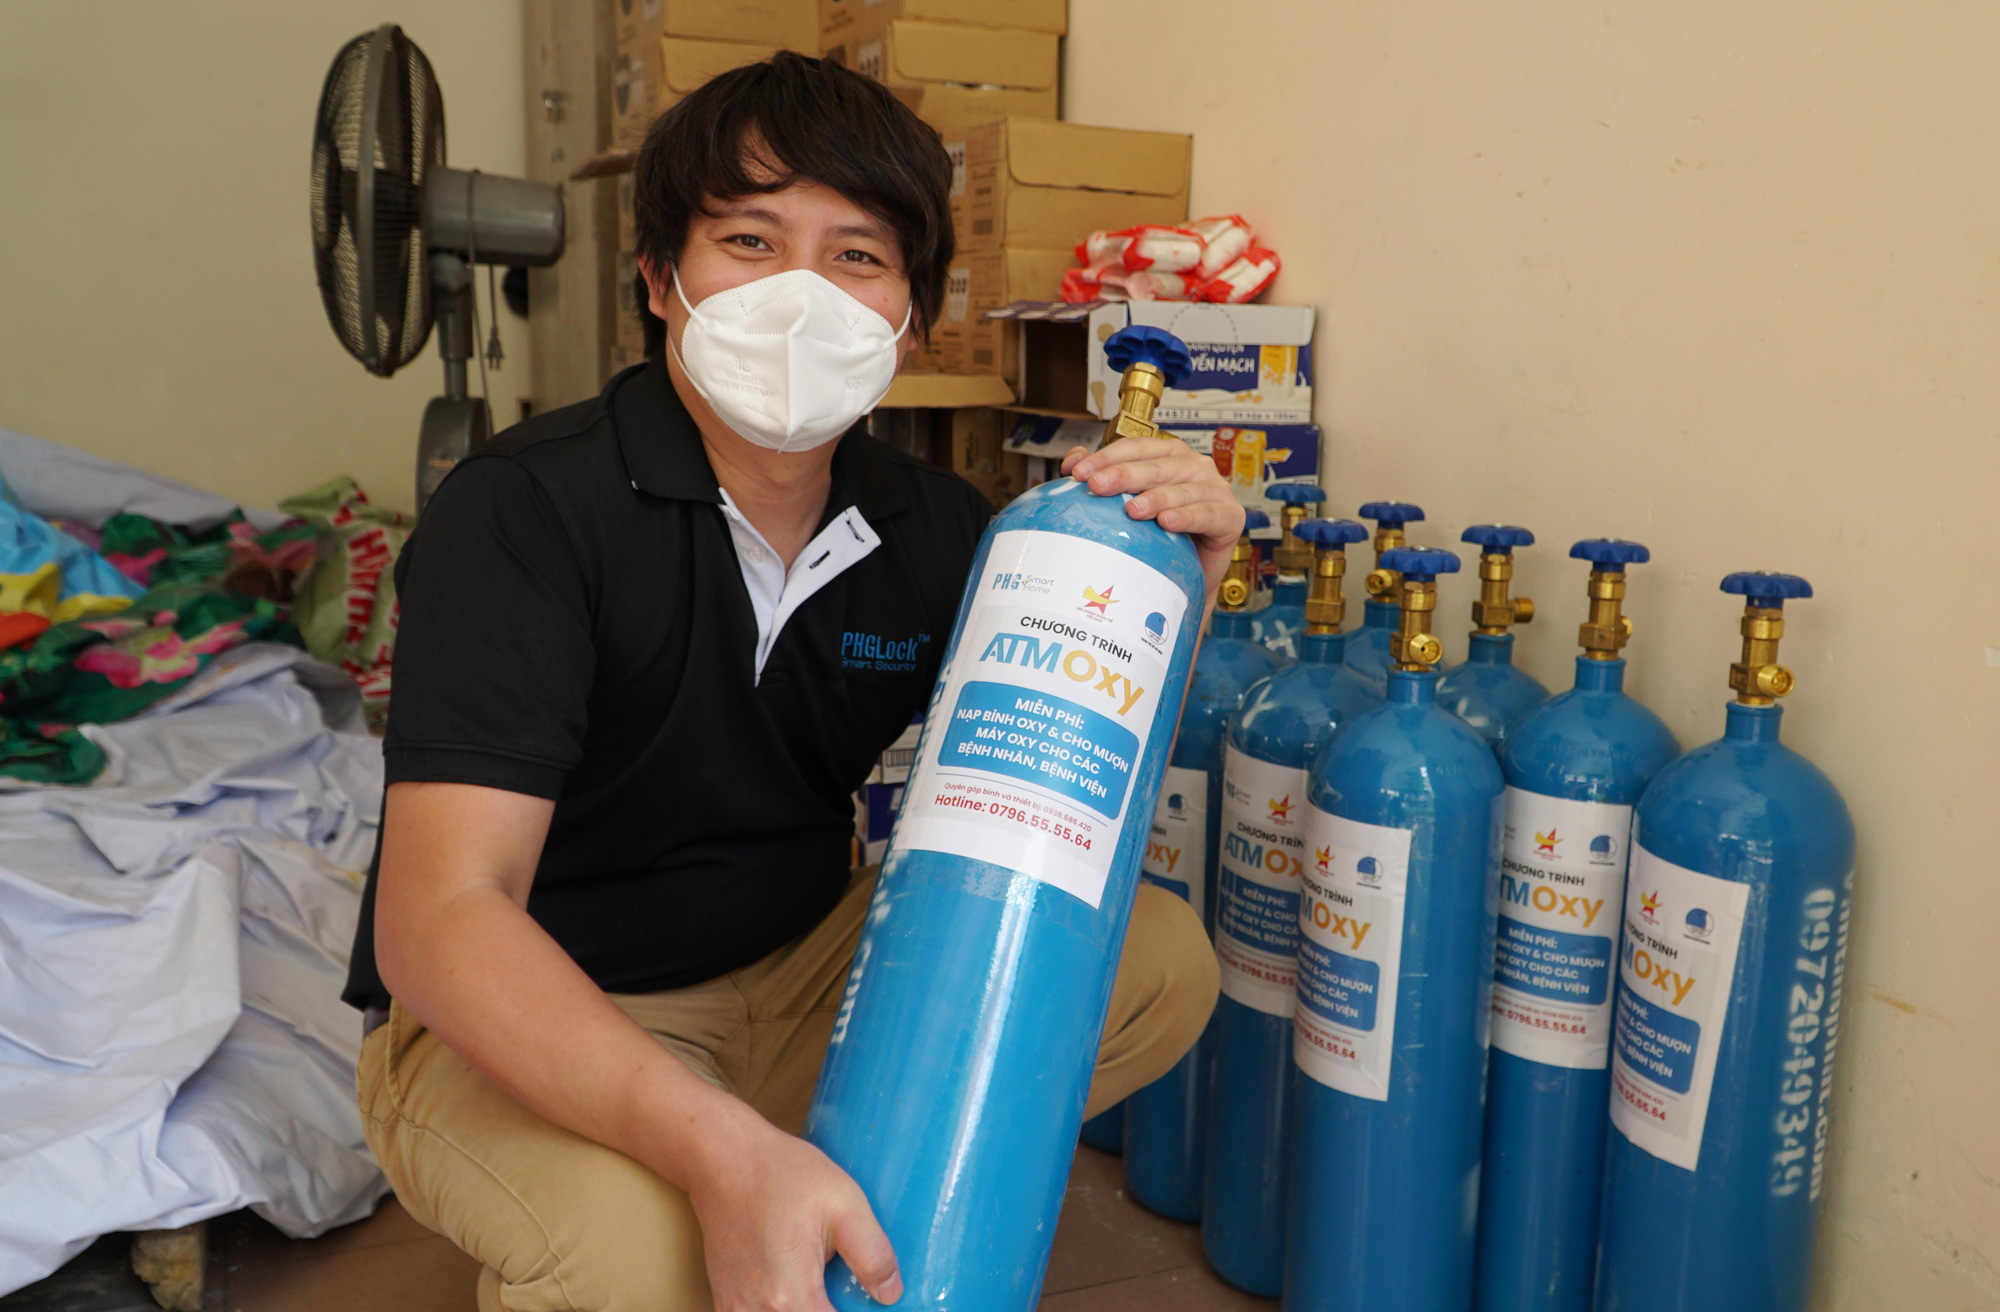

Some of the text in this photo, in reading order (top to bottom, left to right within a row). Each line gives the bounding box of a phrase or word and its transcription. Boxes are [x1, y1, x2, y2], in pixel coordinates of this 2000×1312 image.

[1216, 356, 1256, 376] MẠCH
[992, 573, 1022, 590] PHG
[1022, 584, 1051, 595] Home
[1027, 575, 1055, 587] Smart
[1020, 616, 1088, 642] CHƯƠNG
[1092, 634, 1133, 664] TRÌNH
[841, 657, 917, 673] Smart Security
[1014, 697, 1085, 730] MIỄN PHÍ:
[956, 708, 1130, 774] NẠP BÌNH OXY & CHO MƯỢN
[975, 727, 1101, 775] MÁY OXY CHO CÁC
[957, 741, 1108, 799] BỆNH NHÂN, BỆNH VIỆN
[944, 782, 966, 794] Quyên
[966, 785, 982, 796] góp
[1043, 805, 1092, 833] 0938.686.420
[934, 793, 987, 813] Hotline:
[989, 801, 1092, 851] 0796.55.55.64
[1280, 835, 1304, 849] TRÌN
[1265, 848, 1303, 878] Ox
[1501, 873, 1530, 908] TM
[1548, 871, 1585, 887] TRÌNH
[1324, 887, 1353, 908] TRÌNH
[1647, 936, 1678, 959] TRÌNH
